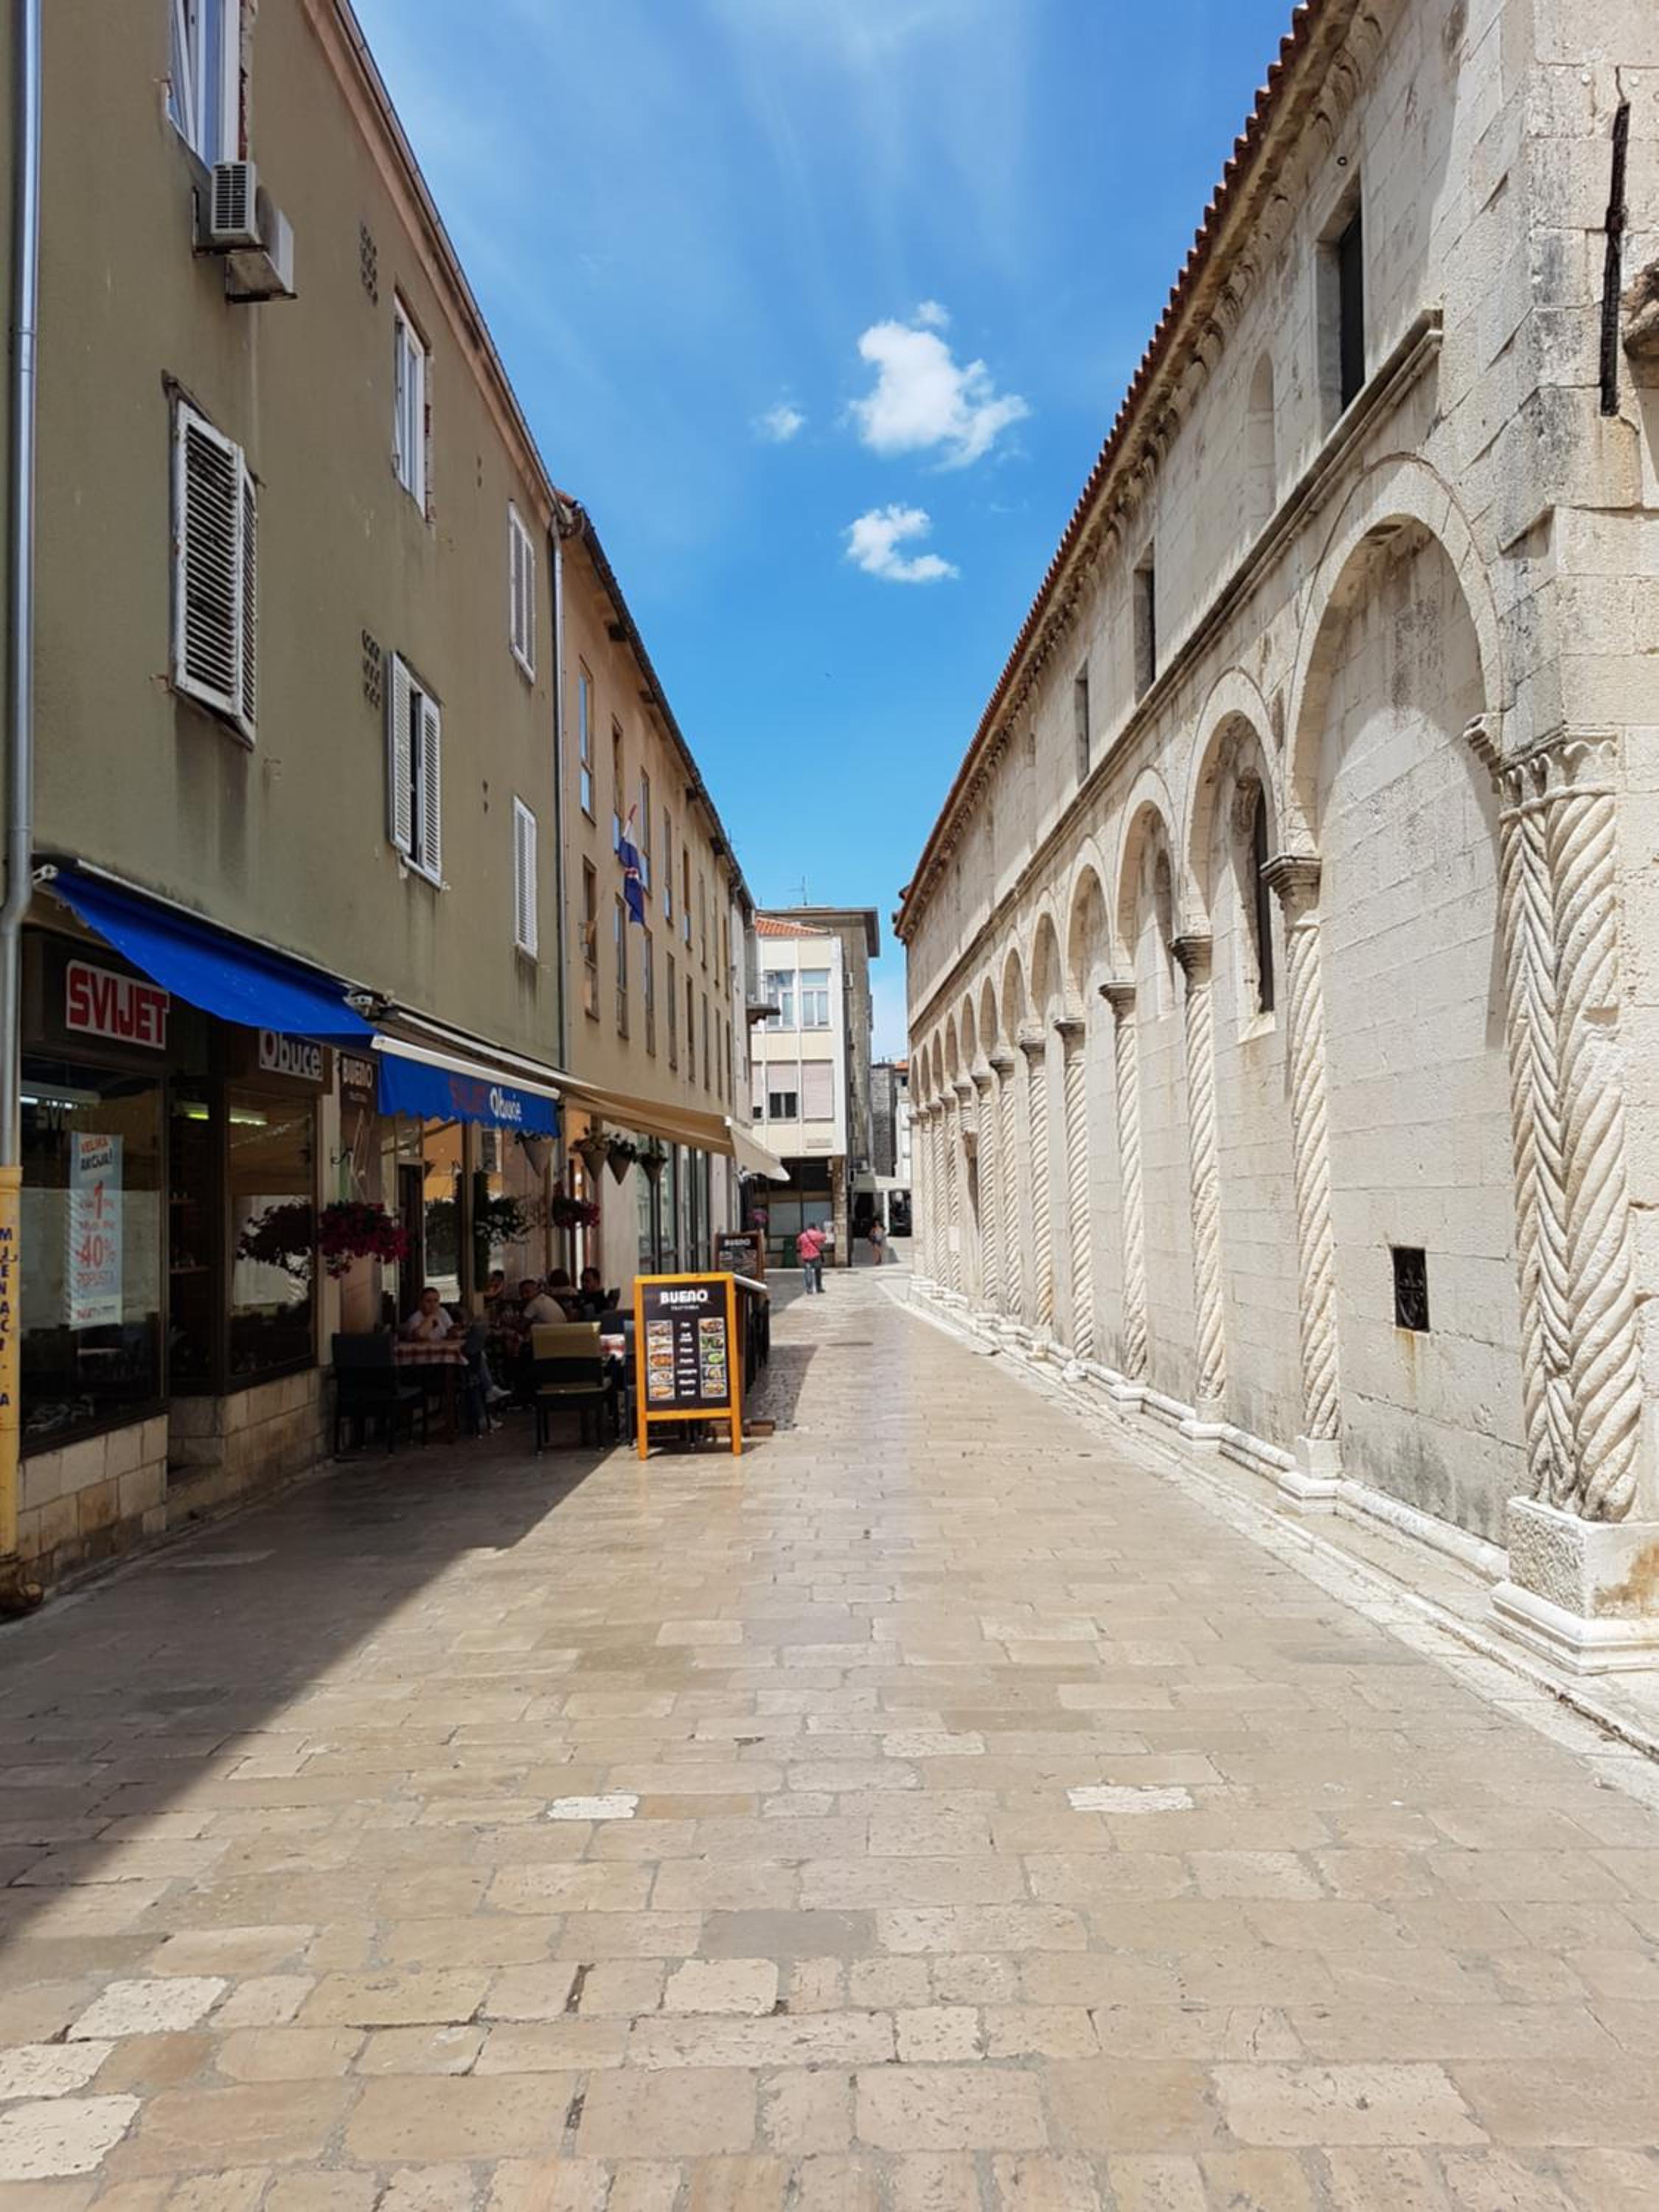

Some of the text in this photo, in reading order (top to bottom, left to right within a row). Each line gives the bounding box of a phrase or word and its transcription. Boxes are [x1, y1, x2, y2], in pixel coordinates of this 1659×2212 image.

[70, 967, 167, 1044] SVIJET
[342, 1056, 373, 1088] BUENO
[660, 1290, 709, 1304] BUENO
